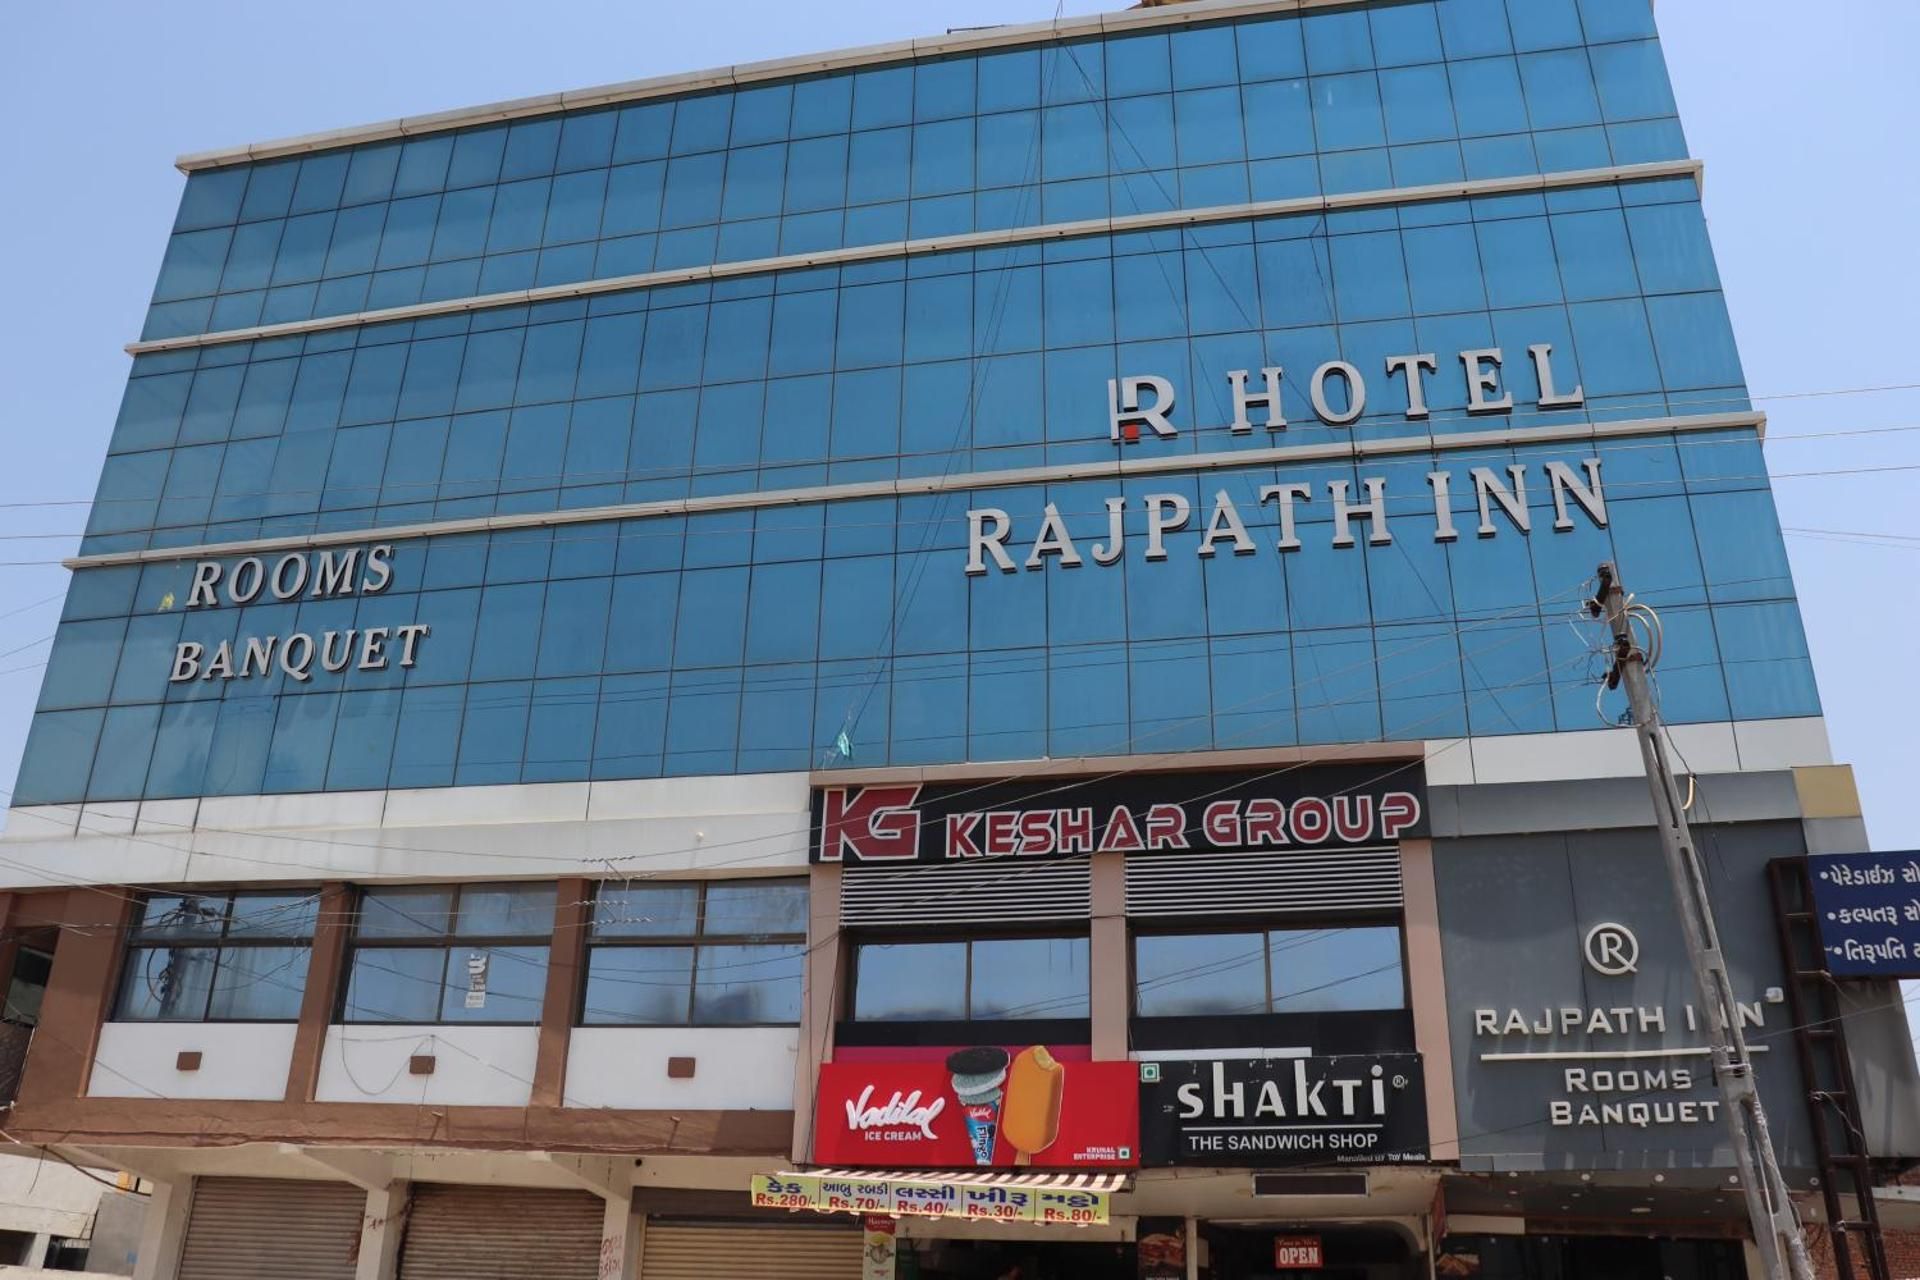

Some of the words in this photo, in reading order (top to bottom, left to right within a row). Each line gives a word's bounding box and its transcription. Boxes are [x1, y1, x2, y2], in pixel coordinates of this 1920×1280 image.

[1227, 343, 1584, 435] HOTEL
[964, 476, 1393, 576] RAJPATH
[1426, 457, 1607, 543] INN
[186, 544, 394, 608] ROOMS
[169, 624, 431, 682] BANQUET
[819, 783, 923, 862] KG
[945, 803, 1190, 858] KESHAR
[1202, 791, 1421, 846] GROUP
[1475, 1004, 1665, 1036] RAJPATH
[1565, 1068, 1693, 1093] ROOMS
[845, 1084, 945, 1139] Vadilal
[1550, 1101, 1720, 1128] BANQUET
[864, 1131, 881, 1141] ICE
[884, 1131, 922, 1141] CREAM
[1189, 1135, 1225, 1151] THE
[1228, 1133, 1324, 1151] SANDWICH
[1329, 1133, 1378, 1149] SHOP
[755, 1193, 817, 1207] Rs.280/-
[829, 1196, 885, 1210] Rs.70/-
[897, 1201, 954, 1214] Rs.40/-
[968, 1204, 1023, 1218] Rs.30/-
[1044, 1208, 1102, 1221] Rs.80/-
[1280, 1247, 1318, 1264] OPEN
